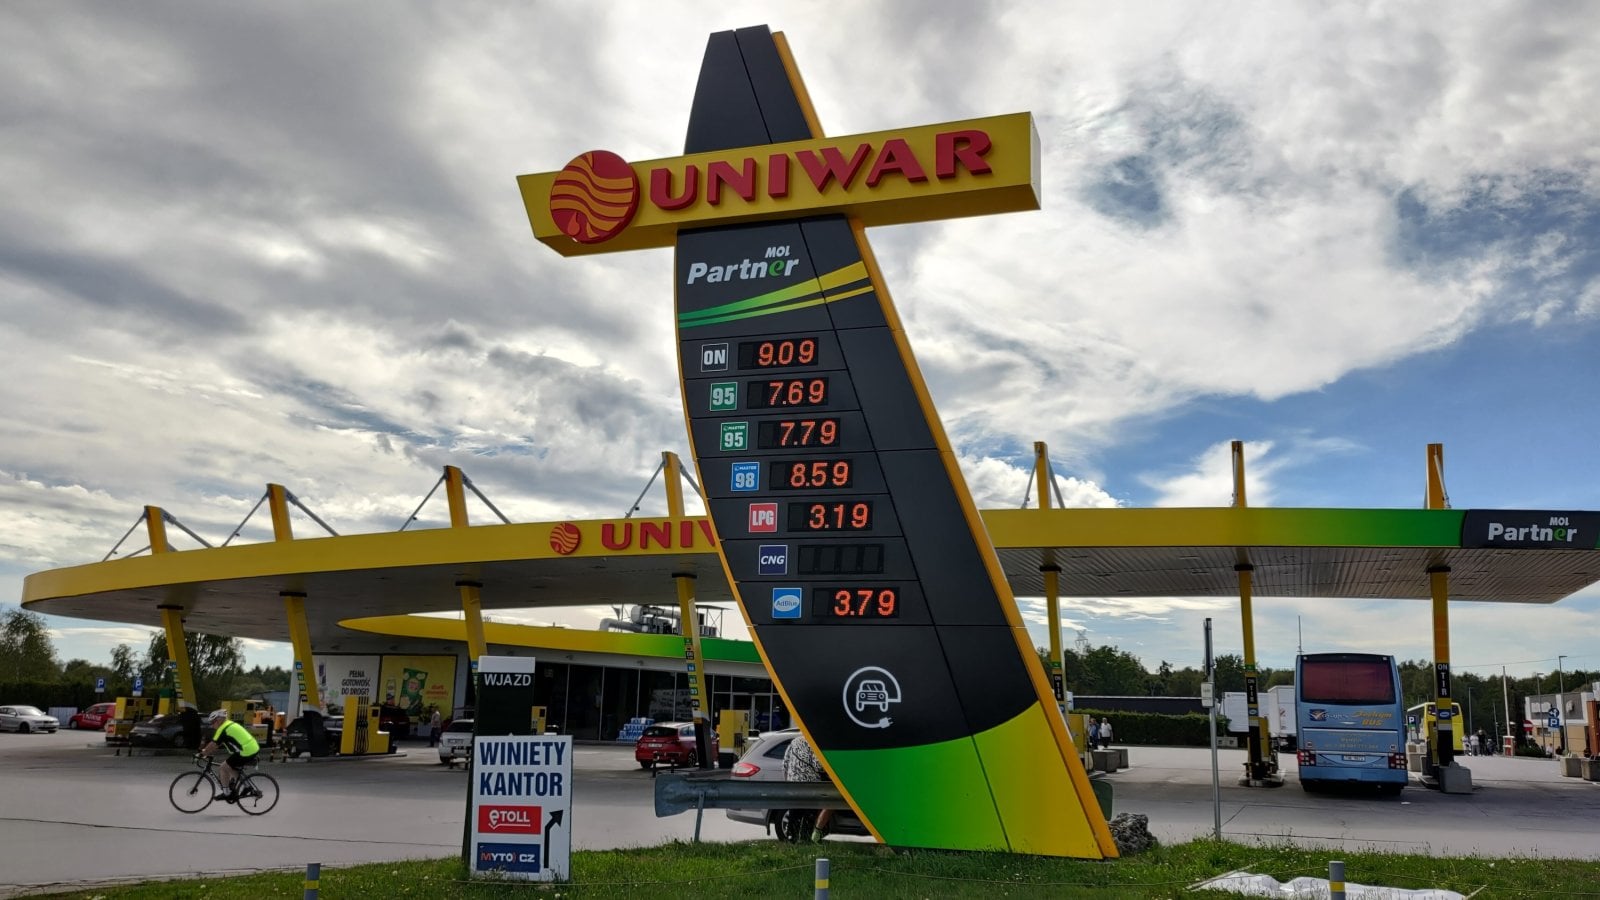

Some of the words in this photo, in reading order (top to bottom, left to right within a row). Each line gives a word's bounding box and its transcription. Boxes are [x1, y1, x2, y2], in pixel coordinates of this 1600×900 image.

[649, 130, 993, 211] UNIWAR
[764, 245, 791, 259] MOL
[687, 258, 800, 285] Partner
[703, 349, 726, 366] ON
[758, 340, 816, 366] 9.09
[712, 387, 735, 406] 95
[769, 379, 825, 406] 7.69
[724, 432, 744, 448] 95
[780, 420, 837, 446] 7.79
[735, 472, 755, 488] 98
[790, 461, 850, 487] 8.59
[751, 511, 774, 526] LPG
[809, 503, 869, 529] 3.19
[1549, 516, 1570, 526] MOL
[1487, 522, 1578, 542] Partner
[760, 555, 785, 566] CNG
[775, 599, 798, 607] AdBlue
[834, 590, 895, 616] 3.79
[341, 687, 349, 696] DO
[484, 673, 532, 687] WJAZD
[1550, 718, 1558, 727] P
[479, 741, 567, 766] WINIETY
[480, 772, 563, 797] KANTOR
[489, 809, 530, 825] eTOLL
[519, 853, 535, 863] CZ
